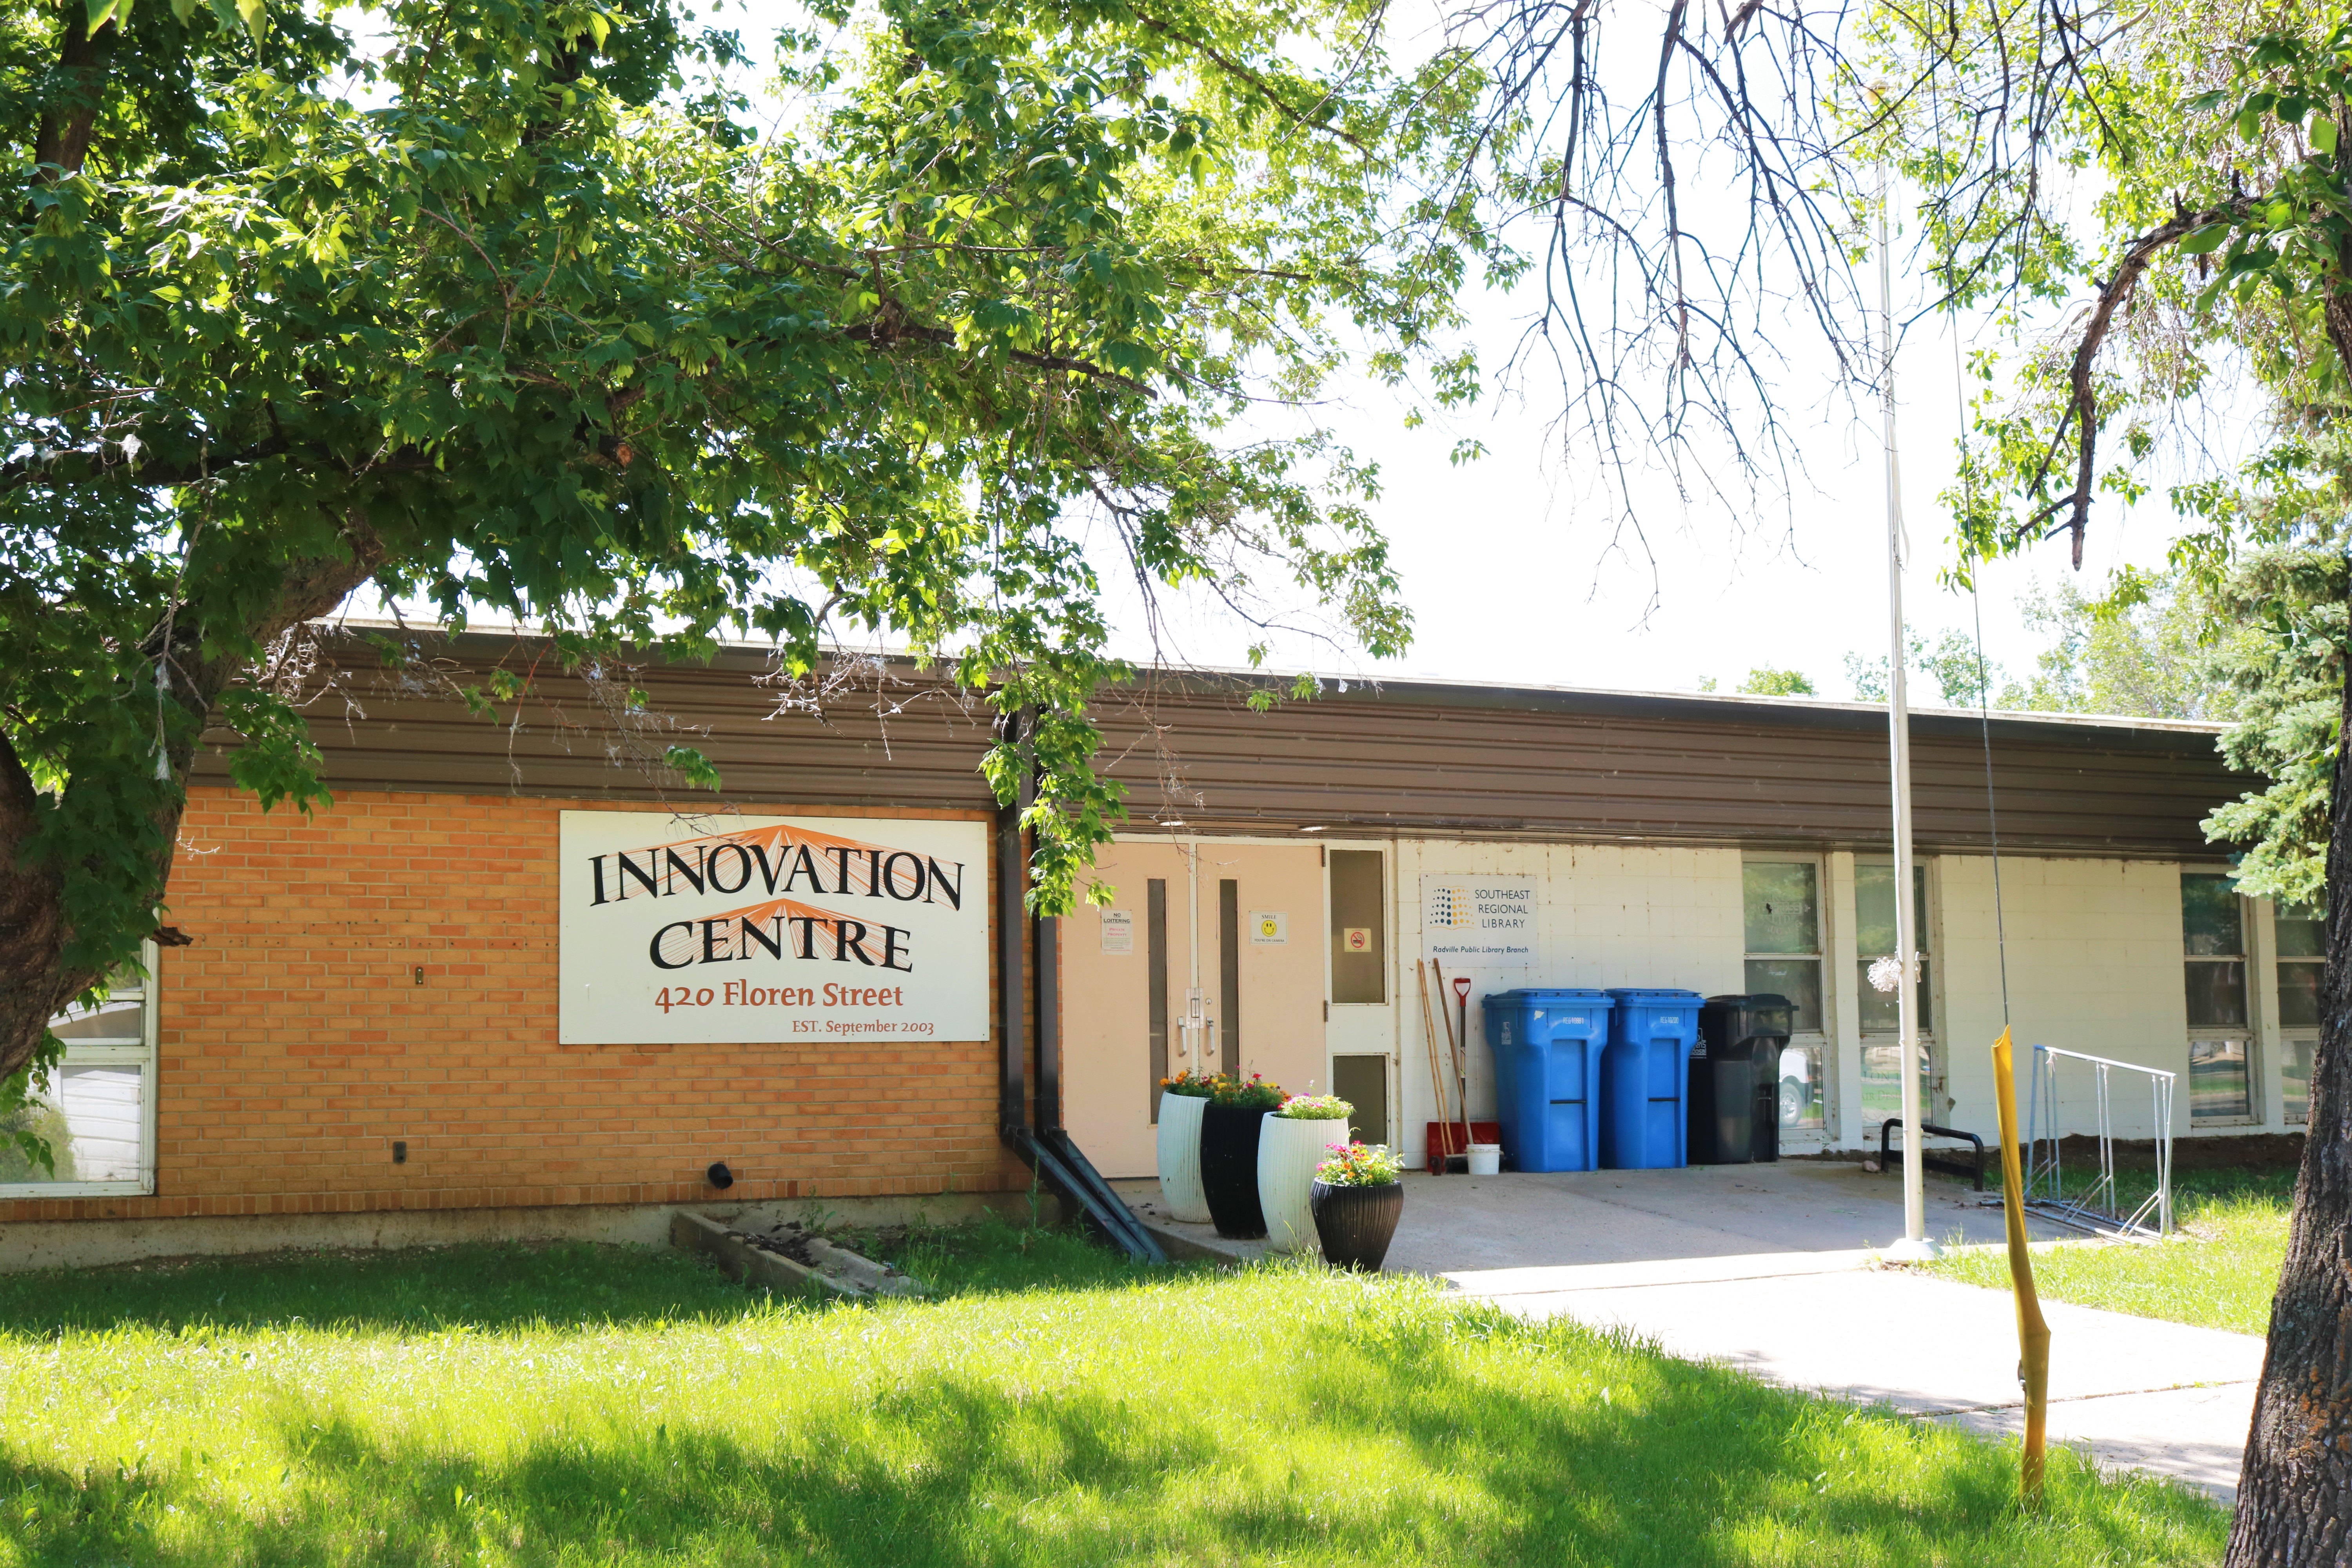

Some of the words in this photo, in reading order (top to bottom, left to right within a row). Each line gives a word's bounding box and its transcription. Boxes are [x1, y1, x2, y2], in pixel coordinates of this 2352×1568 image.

[588, 844, 965, 911] INNOVATION
[1475, 889, 1530, 900] SOUTHEAST
[1479, 904, 1528, 914] REGIONAL
[1482, 919, 1525, 928] LIBRARY
[650, 916, 913, 973] CENTRE
[1482, 946, 1504, 955] Library
[655, 987, 714, 1014] 420
[722, 979, 816, 1006] Floren
[823, 982, 904, 1006] Street
[792, 1020, 822, 1033] EST.
[826, 1020, 898, 1036] September
[901, 1022, 934, 1035] 2003
